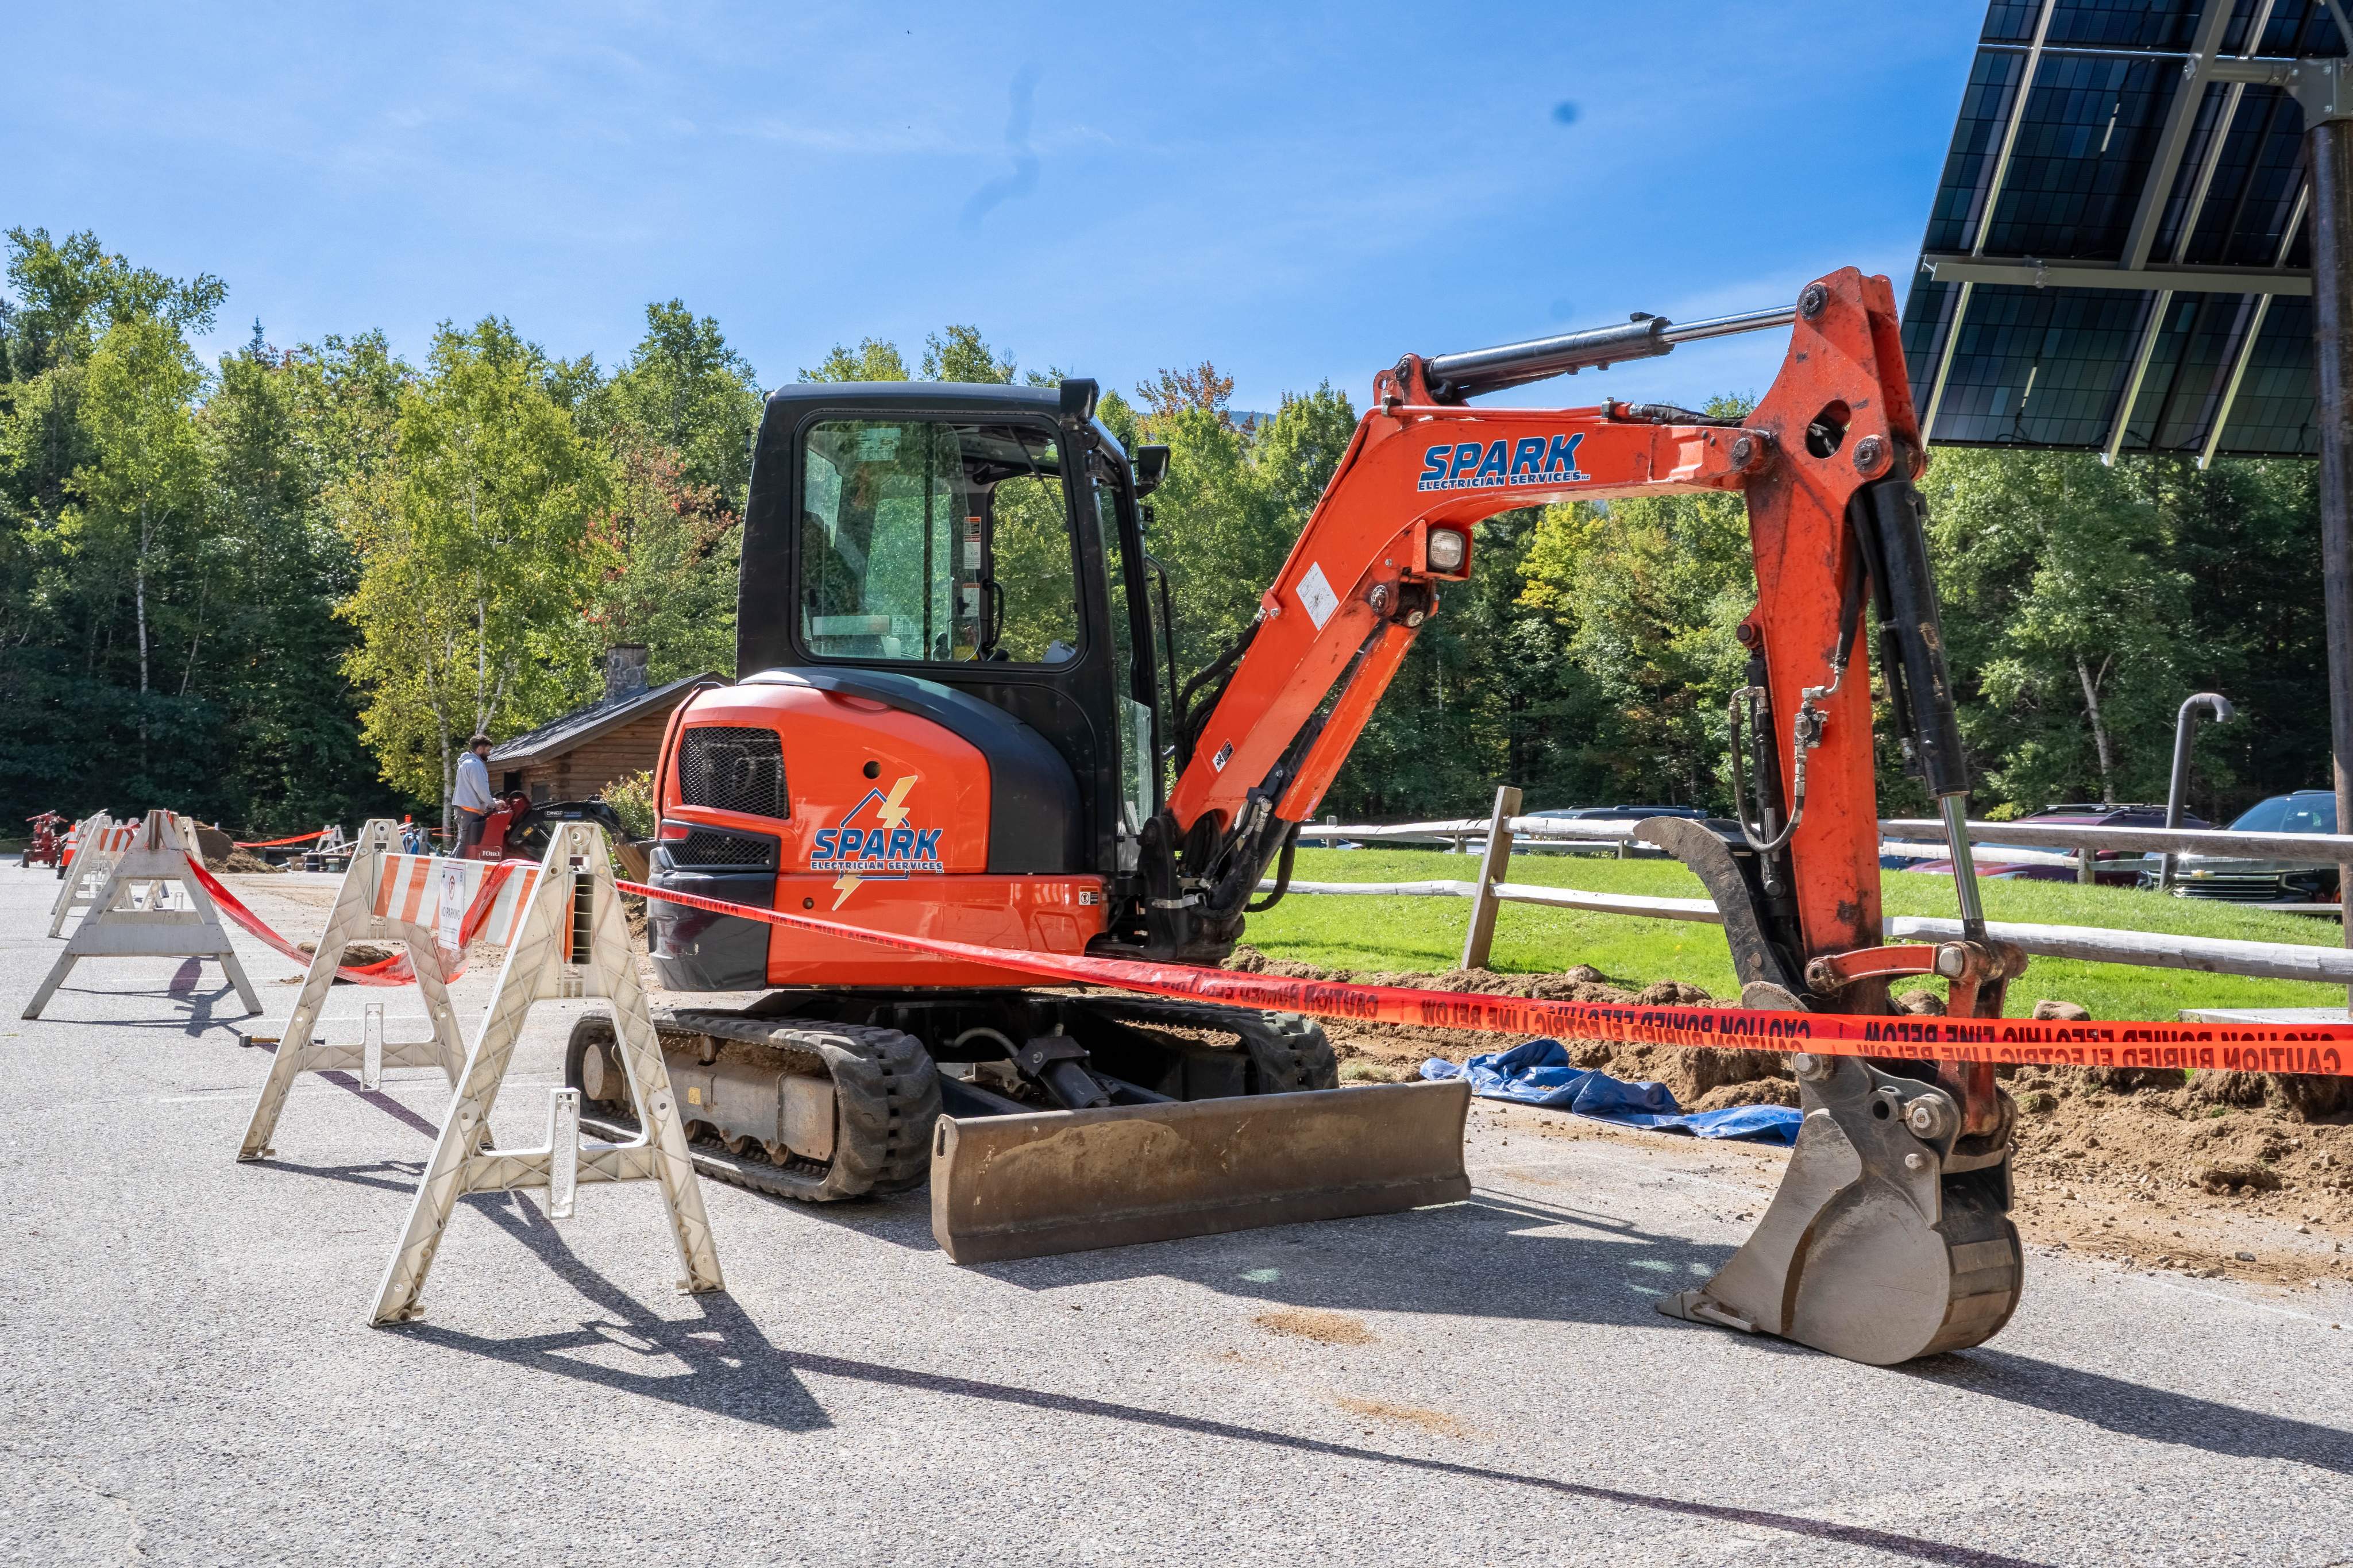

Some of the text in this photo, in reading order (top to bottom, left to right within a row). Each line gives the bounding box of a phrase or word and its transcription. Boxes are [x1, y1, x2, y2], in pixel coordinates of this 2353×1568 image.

[1419, 433, 1585, 481] SPARK
[1418, 476, 1505, 491] ELECTRICIAN
[1510, 471, 1581, 485] SERVICES
[811, 829, 943, 860] SPARK
[811, 861, 884, 870] ELECTRICIAN
[888, 861, 943, 870] SERVICES
[441, 906, 460, 920] NO PARKING
